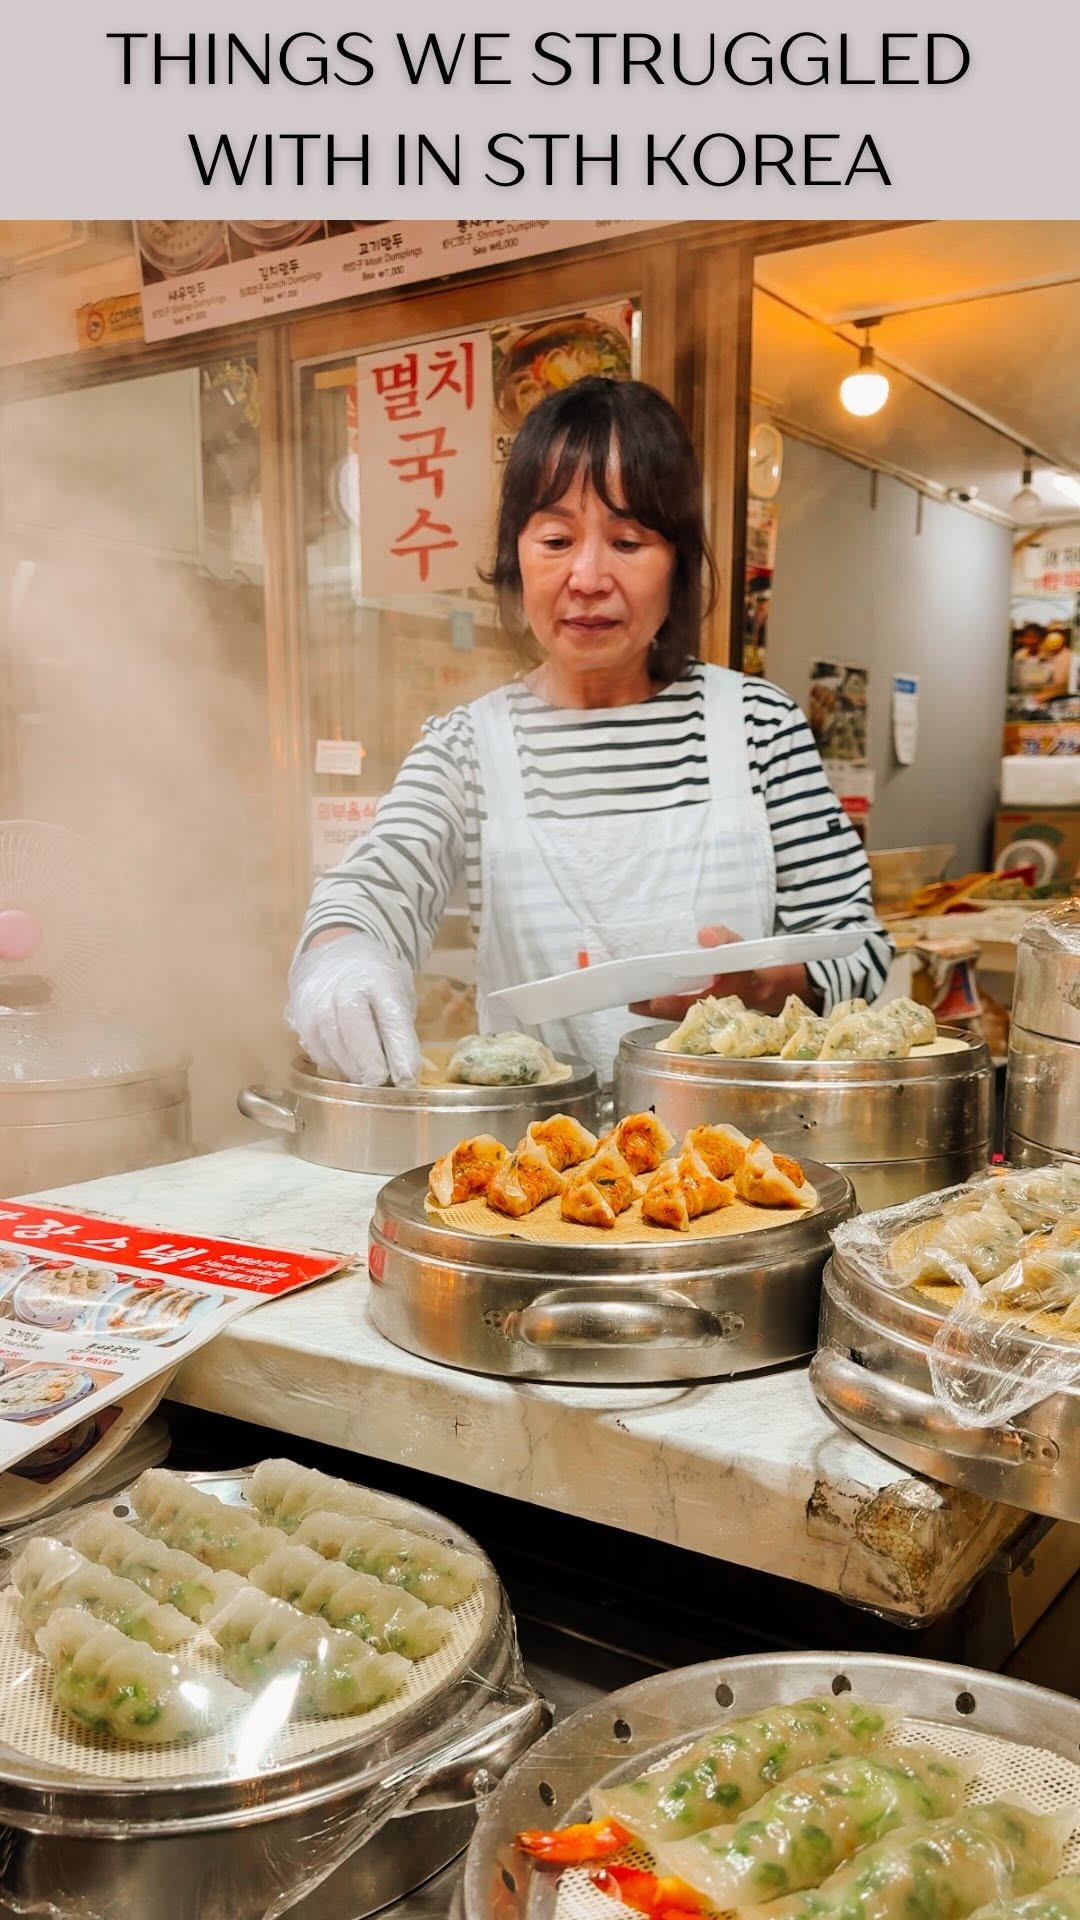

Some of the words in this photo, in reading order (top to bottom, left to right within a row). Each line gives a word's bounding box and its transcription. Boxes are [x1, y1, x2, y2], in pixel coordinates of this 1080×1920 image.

[359, 233, 403, 255] 고기만두
[384, 247, 423, 263] Dumplings
[259, 259, 299, 281] 김치만두
[168, 281, 206, 301] 새우만두
